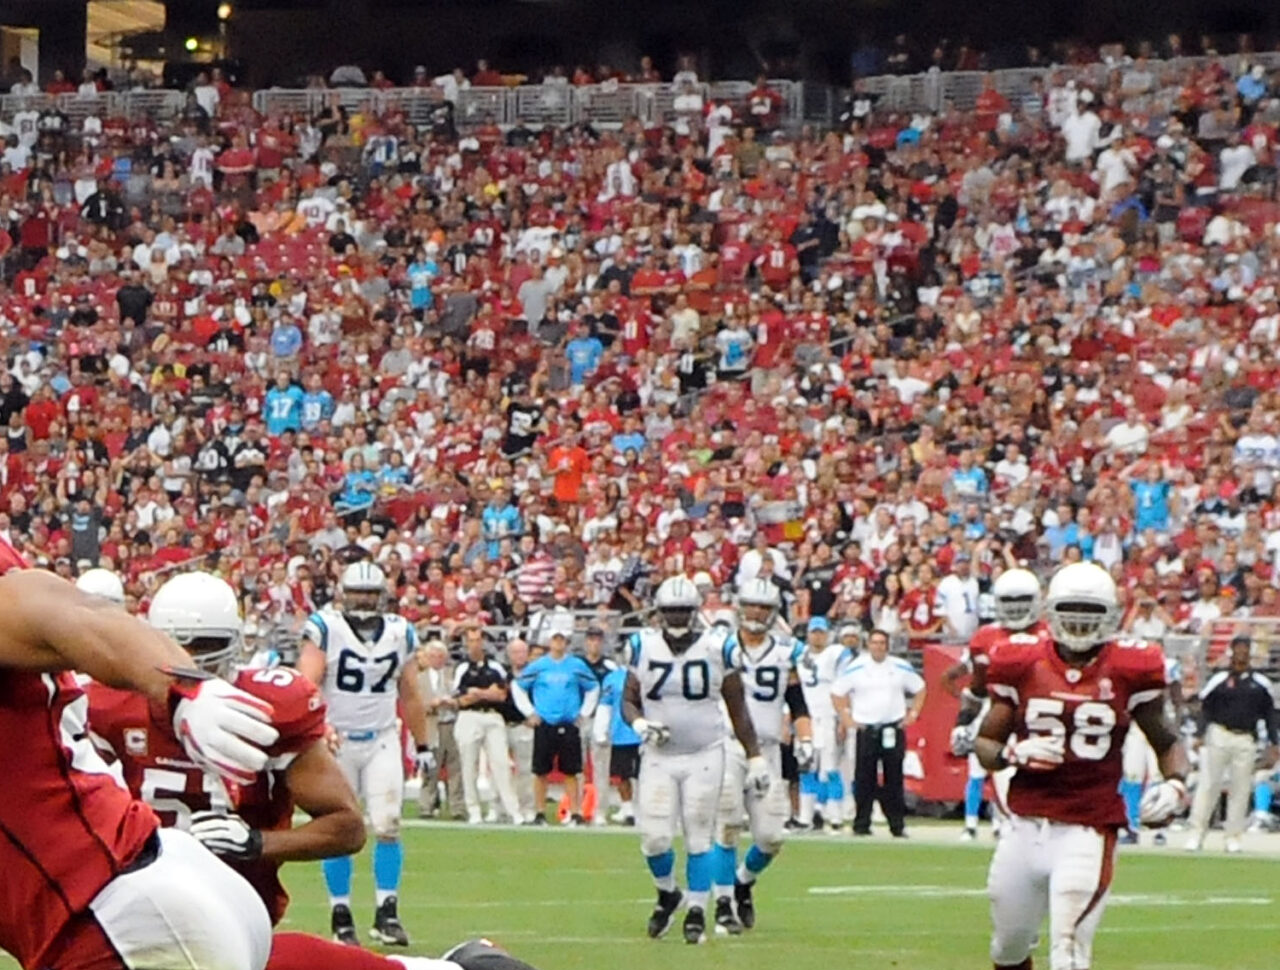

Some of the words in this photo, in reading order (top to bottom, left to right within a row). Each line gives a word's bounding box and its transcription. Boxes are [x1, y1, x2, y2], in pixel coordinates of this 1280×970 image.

[336, 648, 399, 693] 67
[646, 659, 710, 701] 70
[1025, 698, 1117, 760] 58
